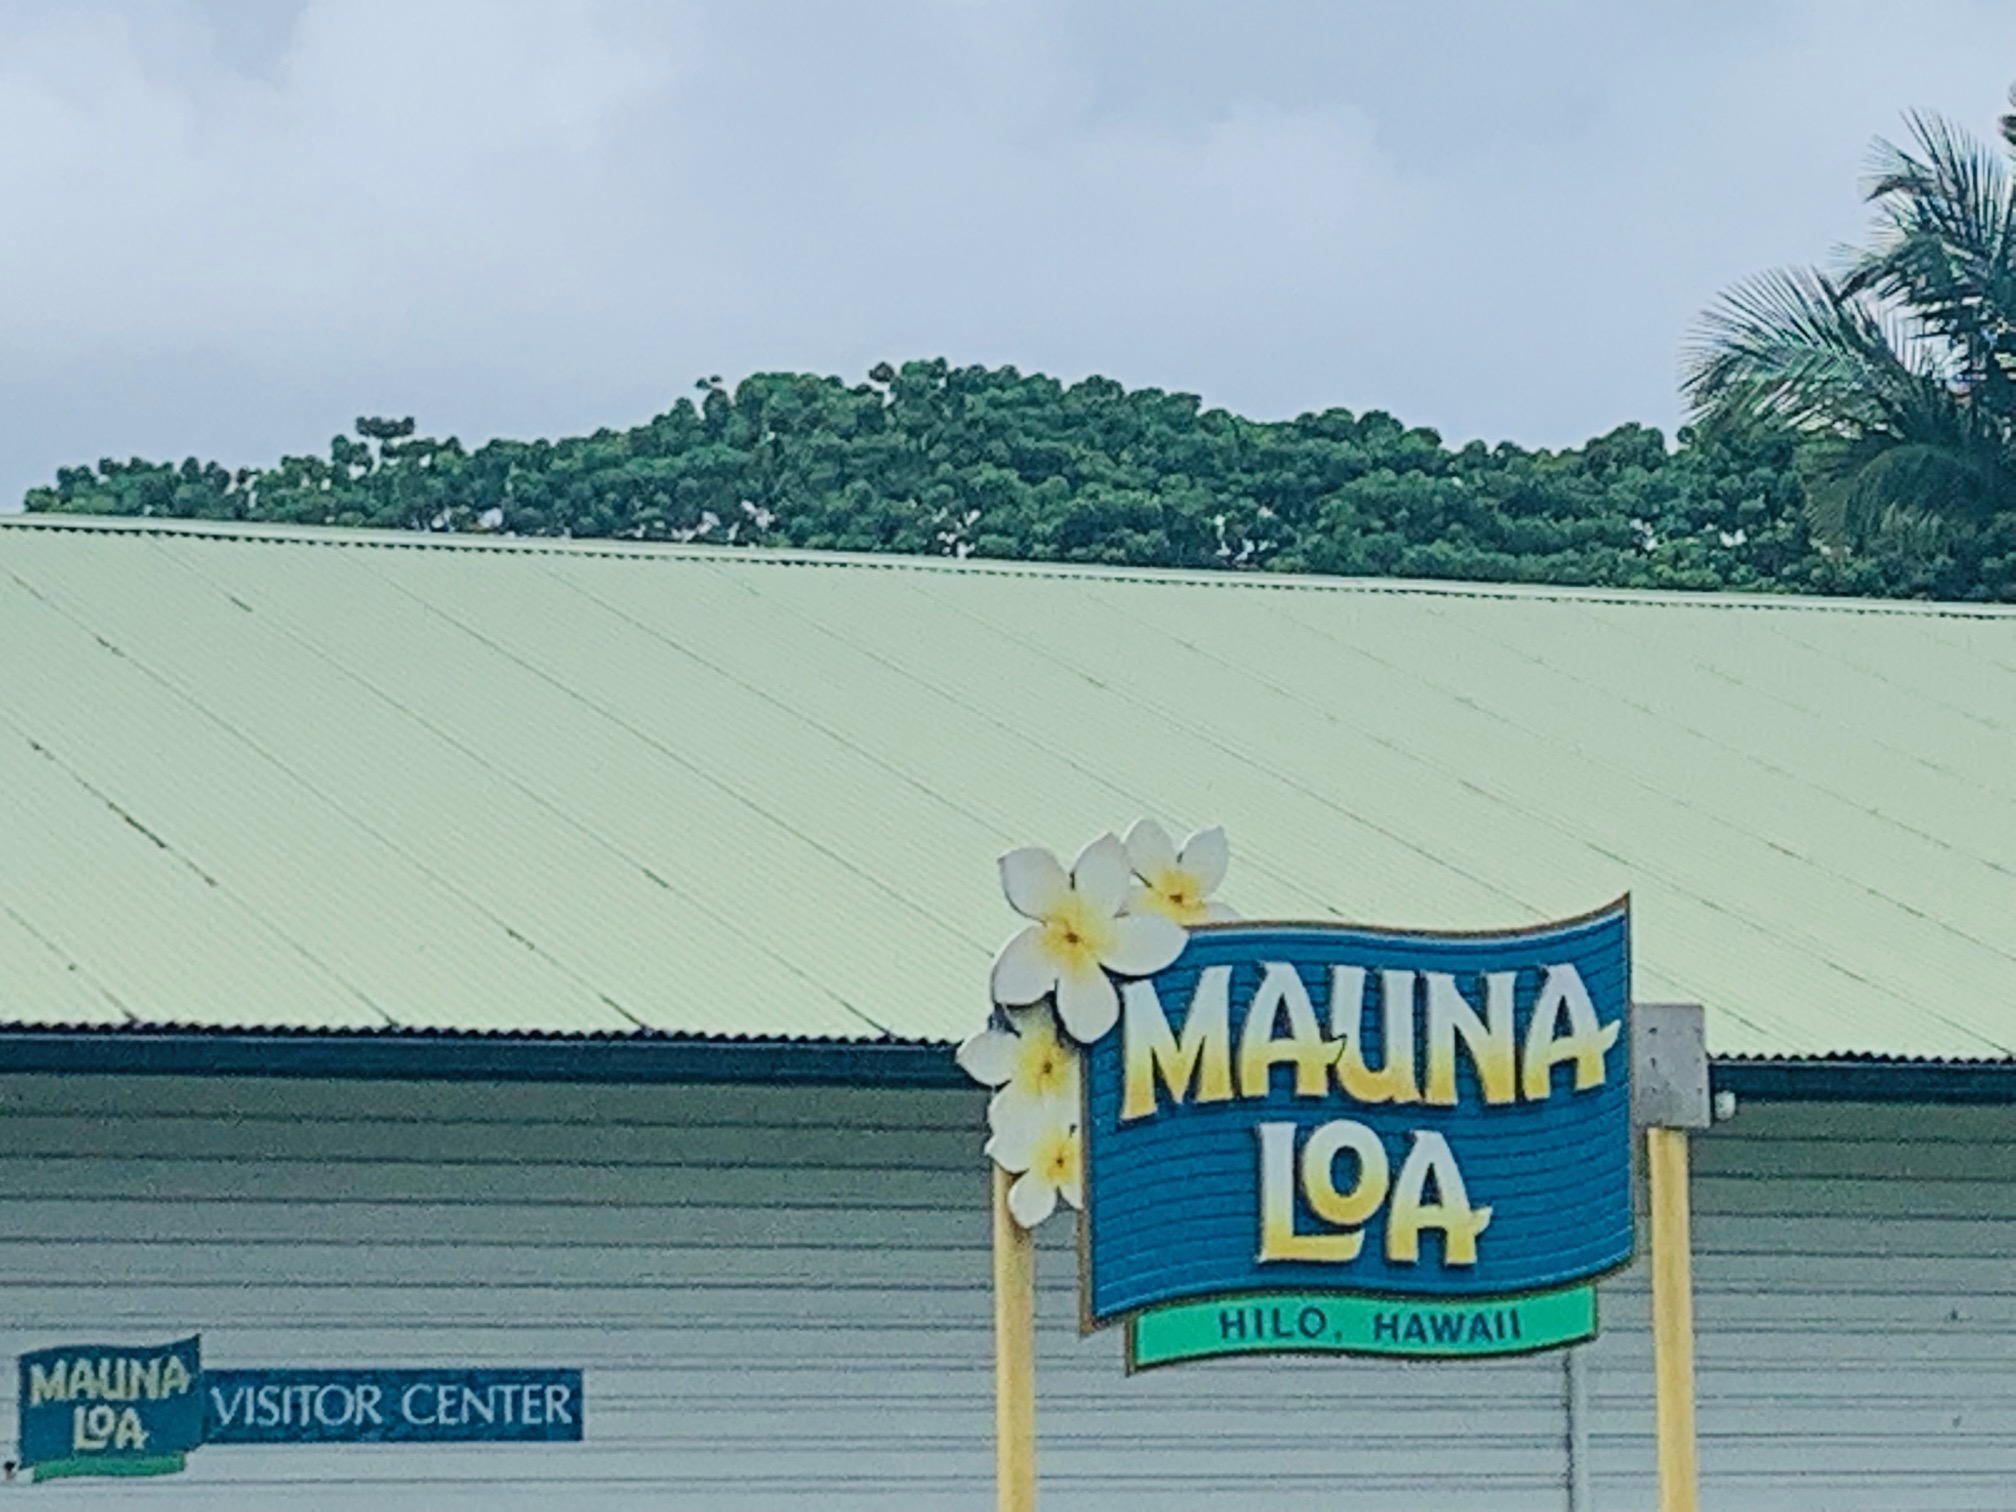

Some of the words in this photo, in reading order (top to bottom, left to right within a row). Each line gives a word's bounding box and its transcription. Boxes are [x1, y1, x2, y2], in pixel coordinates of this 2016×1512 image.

[1119, 962, 1621, 1121] MAUNA
[1256, 1119, 1493, 1265] LOA
[1219, 1306, 1343, 1342] HILO,
[1373, 1308, 1522, 1343] HAWAII
[30, 1355, 191, 1407] MAUNA
[210, 1384, 383, 1427] VISITOR
[401, 1383, 573, 1427] CENTER
[73, 1404, 149, 1450] LOA
